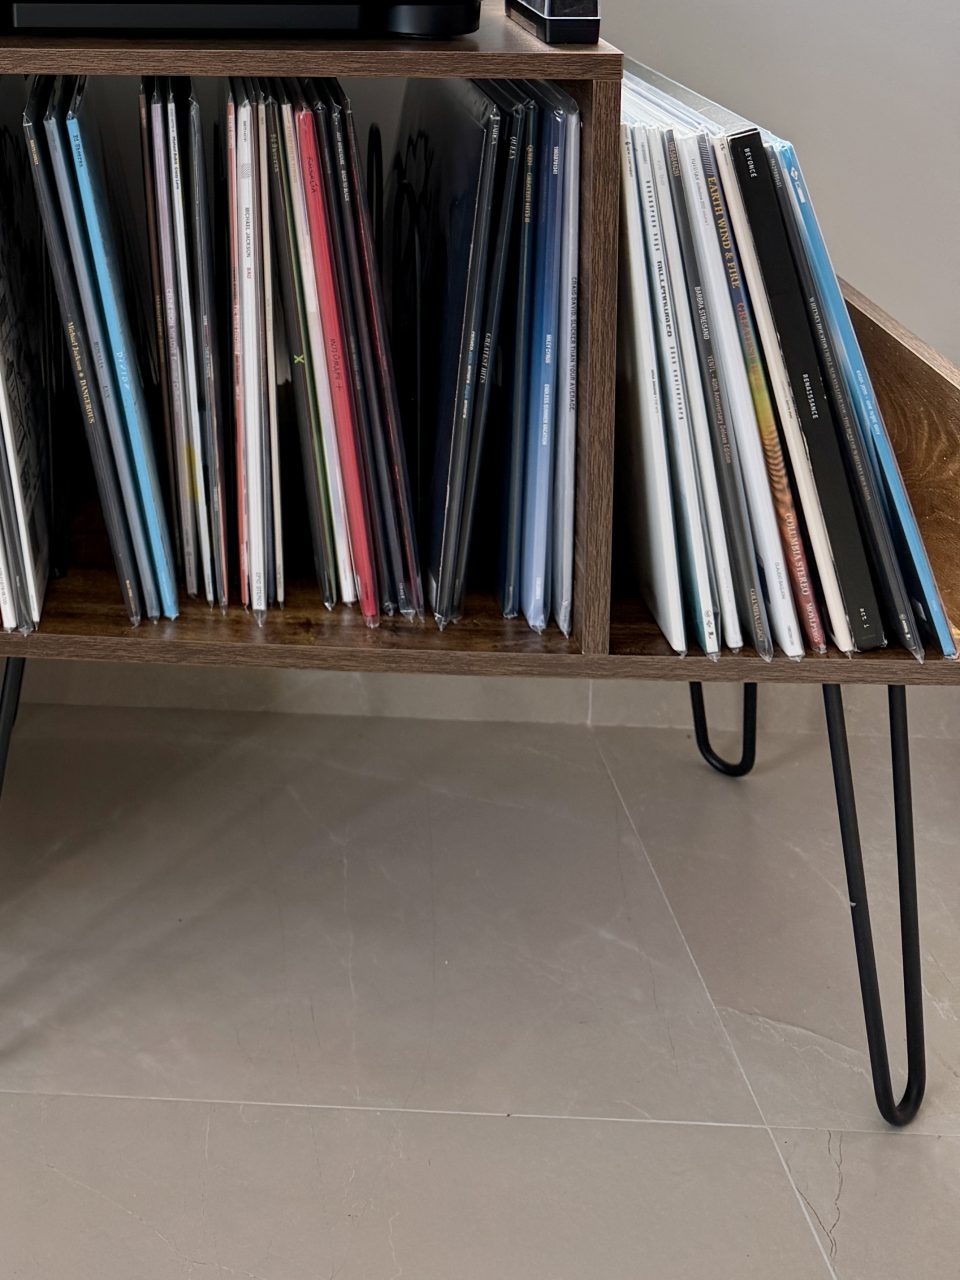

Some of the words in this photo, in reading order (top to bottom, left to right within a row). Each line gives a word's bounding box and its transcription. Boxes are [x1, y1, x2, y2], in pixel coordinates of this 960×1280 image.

[707, 176, 723, 215] EARTH
[716, 218, 731, 250] WIND
[724, 251, 733, 259] &
[726, 261, 740, 288] FIRE
[693, 285, 704, 308] BARBRA
[697, 309, 710, 340] STREISAND
[481, 332, 491, 366] GREATEST
[66, 321, 78, 346] Michael
[72, 346, 83, 371] Jackson
[79, 379, 94, 424] DANGEROUS
[479, 366, 487, 383] HITS
[711, 391, 724, 424] Anniversary
[801, 373, 818, 419] RENAISSANCE
[795, 561, 809, 595] STEREO
